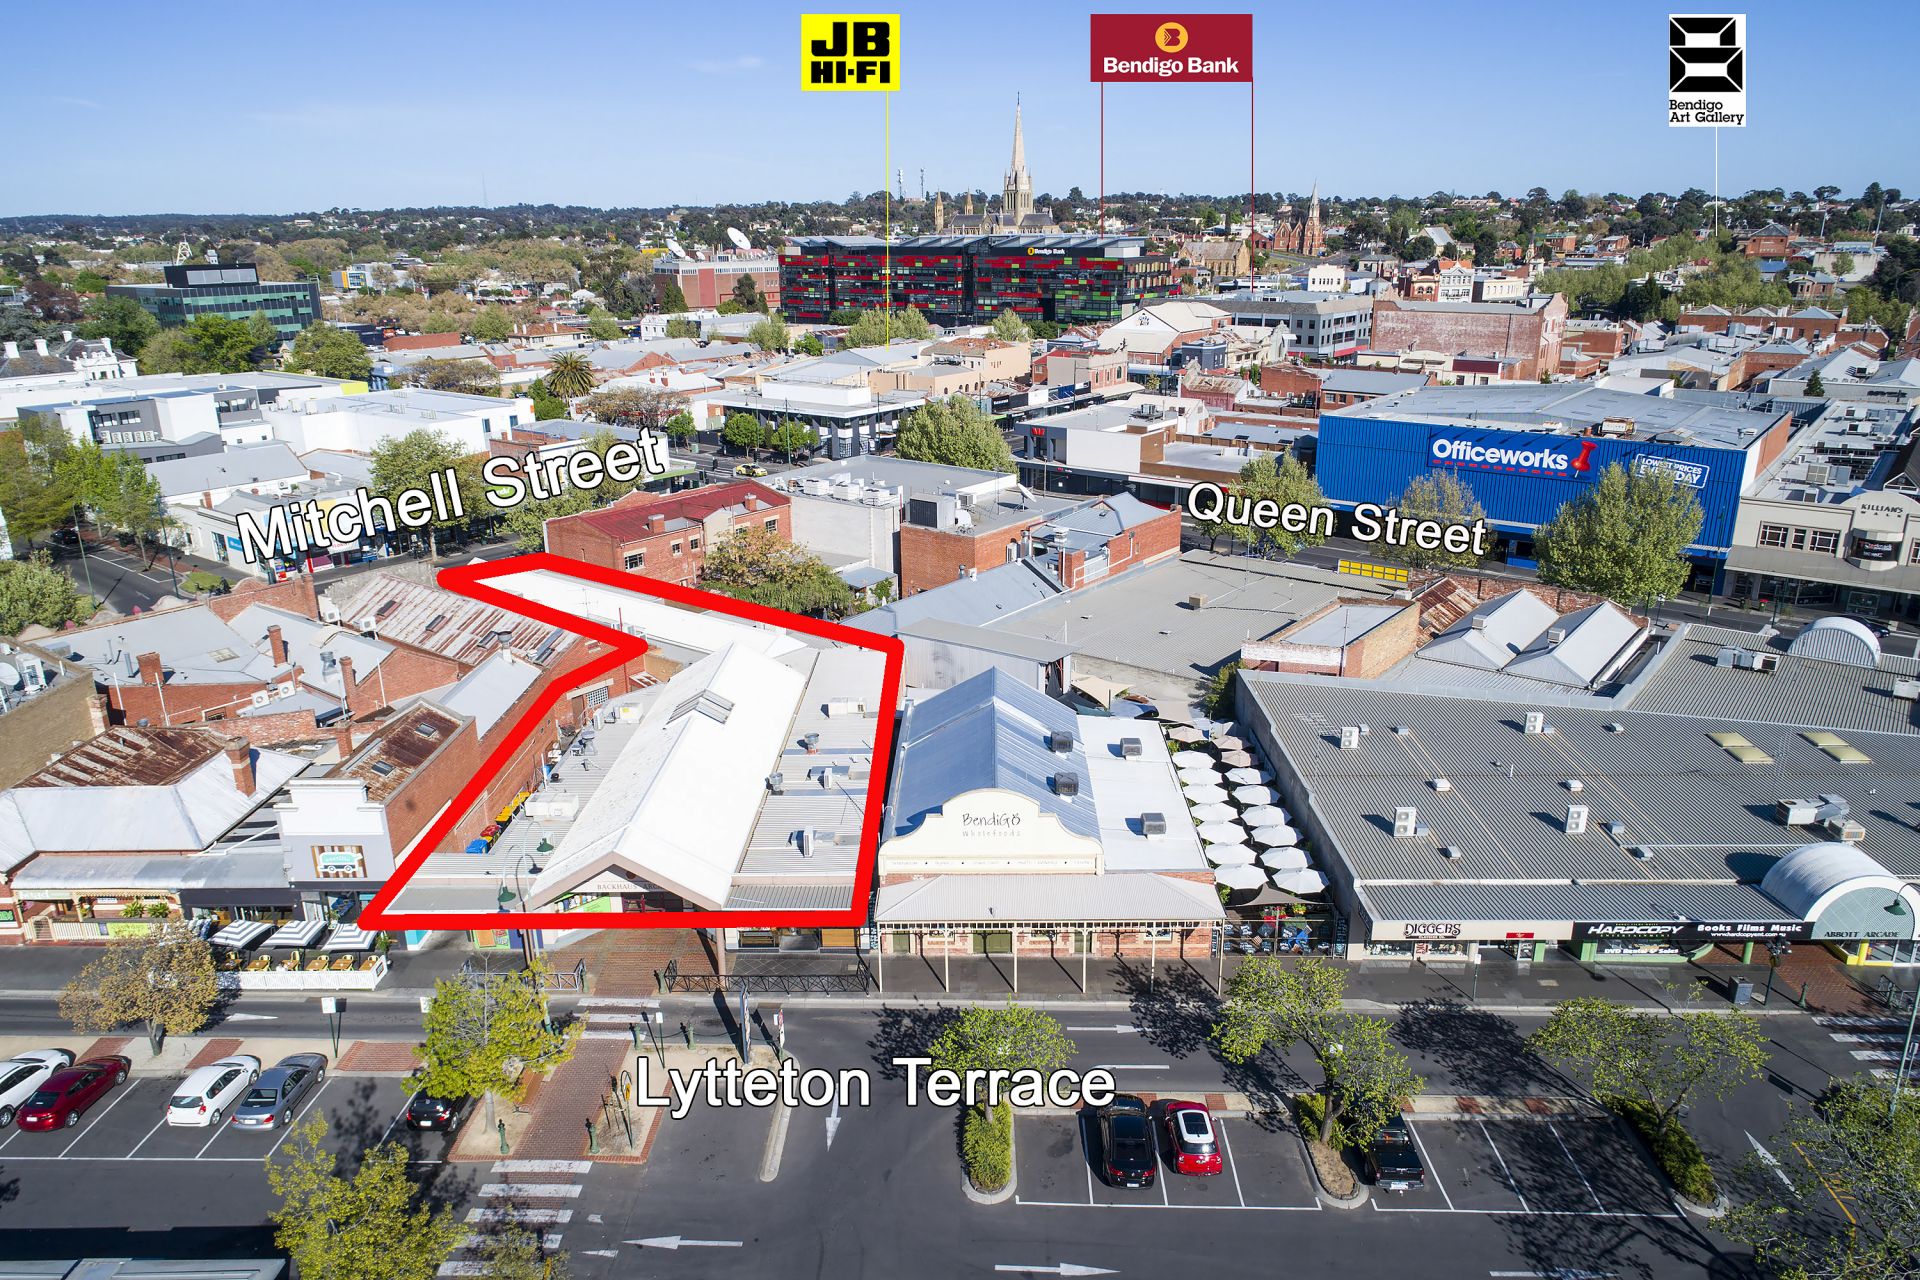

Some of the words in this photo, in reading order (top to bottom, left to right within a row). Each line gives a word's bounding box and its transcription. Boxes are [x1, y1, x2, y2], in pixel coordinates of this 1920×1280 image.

[1432, 437, 1569, 471] Officeworks
[1674, 463, 1703, 475] PRICES
[1861, 504, 1903, 513] KILLIAN'S
[597, 883, 638, 891] BACKHAUS
[1404, 923, 1461, 936] DIGGERS
[1587, 923, 1684, 935] HARDCOPY
[1697, 924, 1732, 932] Books
[1737, 924, 1765, 932] Films
[1770, 924, 1803, 932] Music
